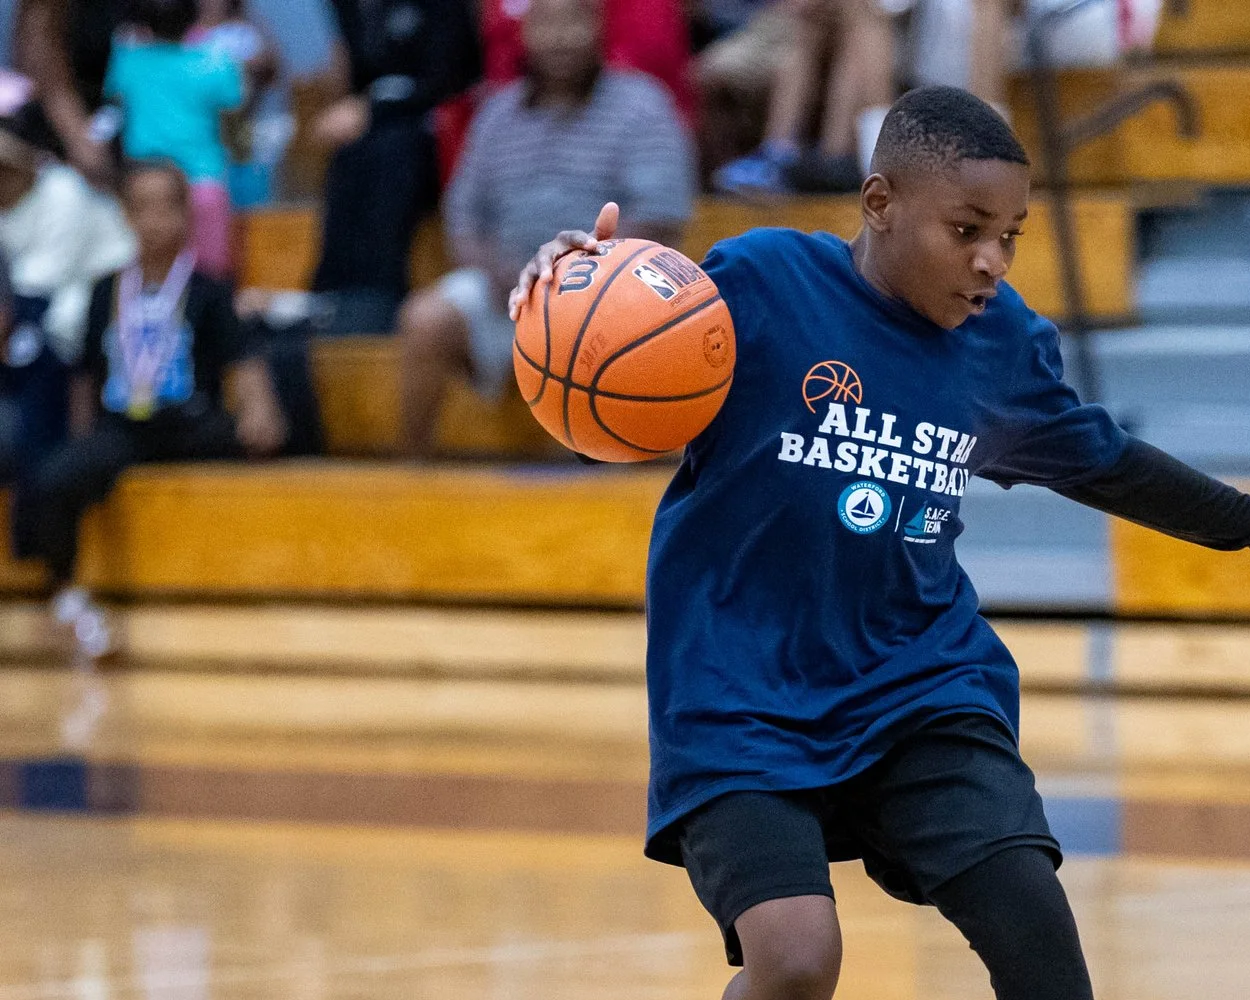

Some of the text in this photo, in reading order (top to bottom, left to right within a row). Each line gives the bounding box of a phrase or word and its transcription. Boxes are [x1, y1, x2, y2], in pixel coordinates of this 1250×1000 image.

[818, 402, 902, 448] ALL
[850, 482, 886, 497] WATERFORD
[840, 512, 883, 532] SCHOOL DISTRICT
[923, 519, 942, 534] TEAM
